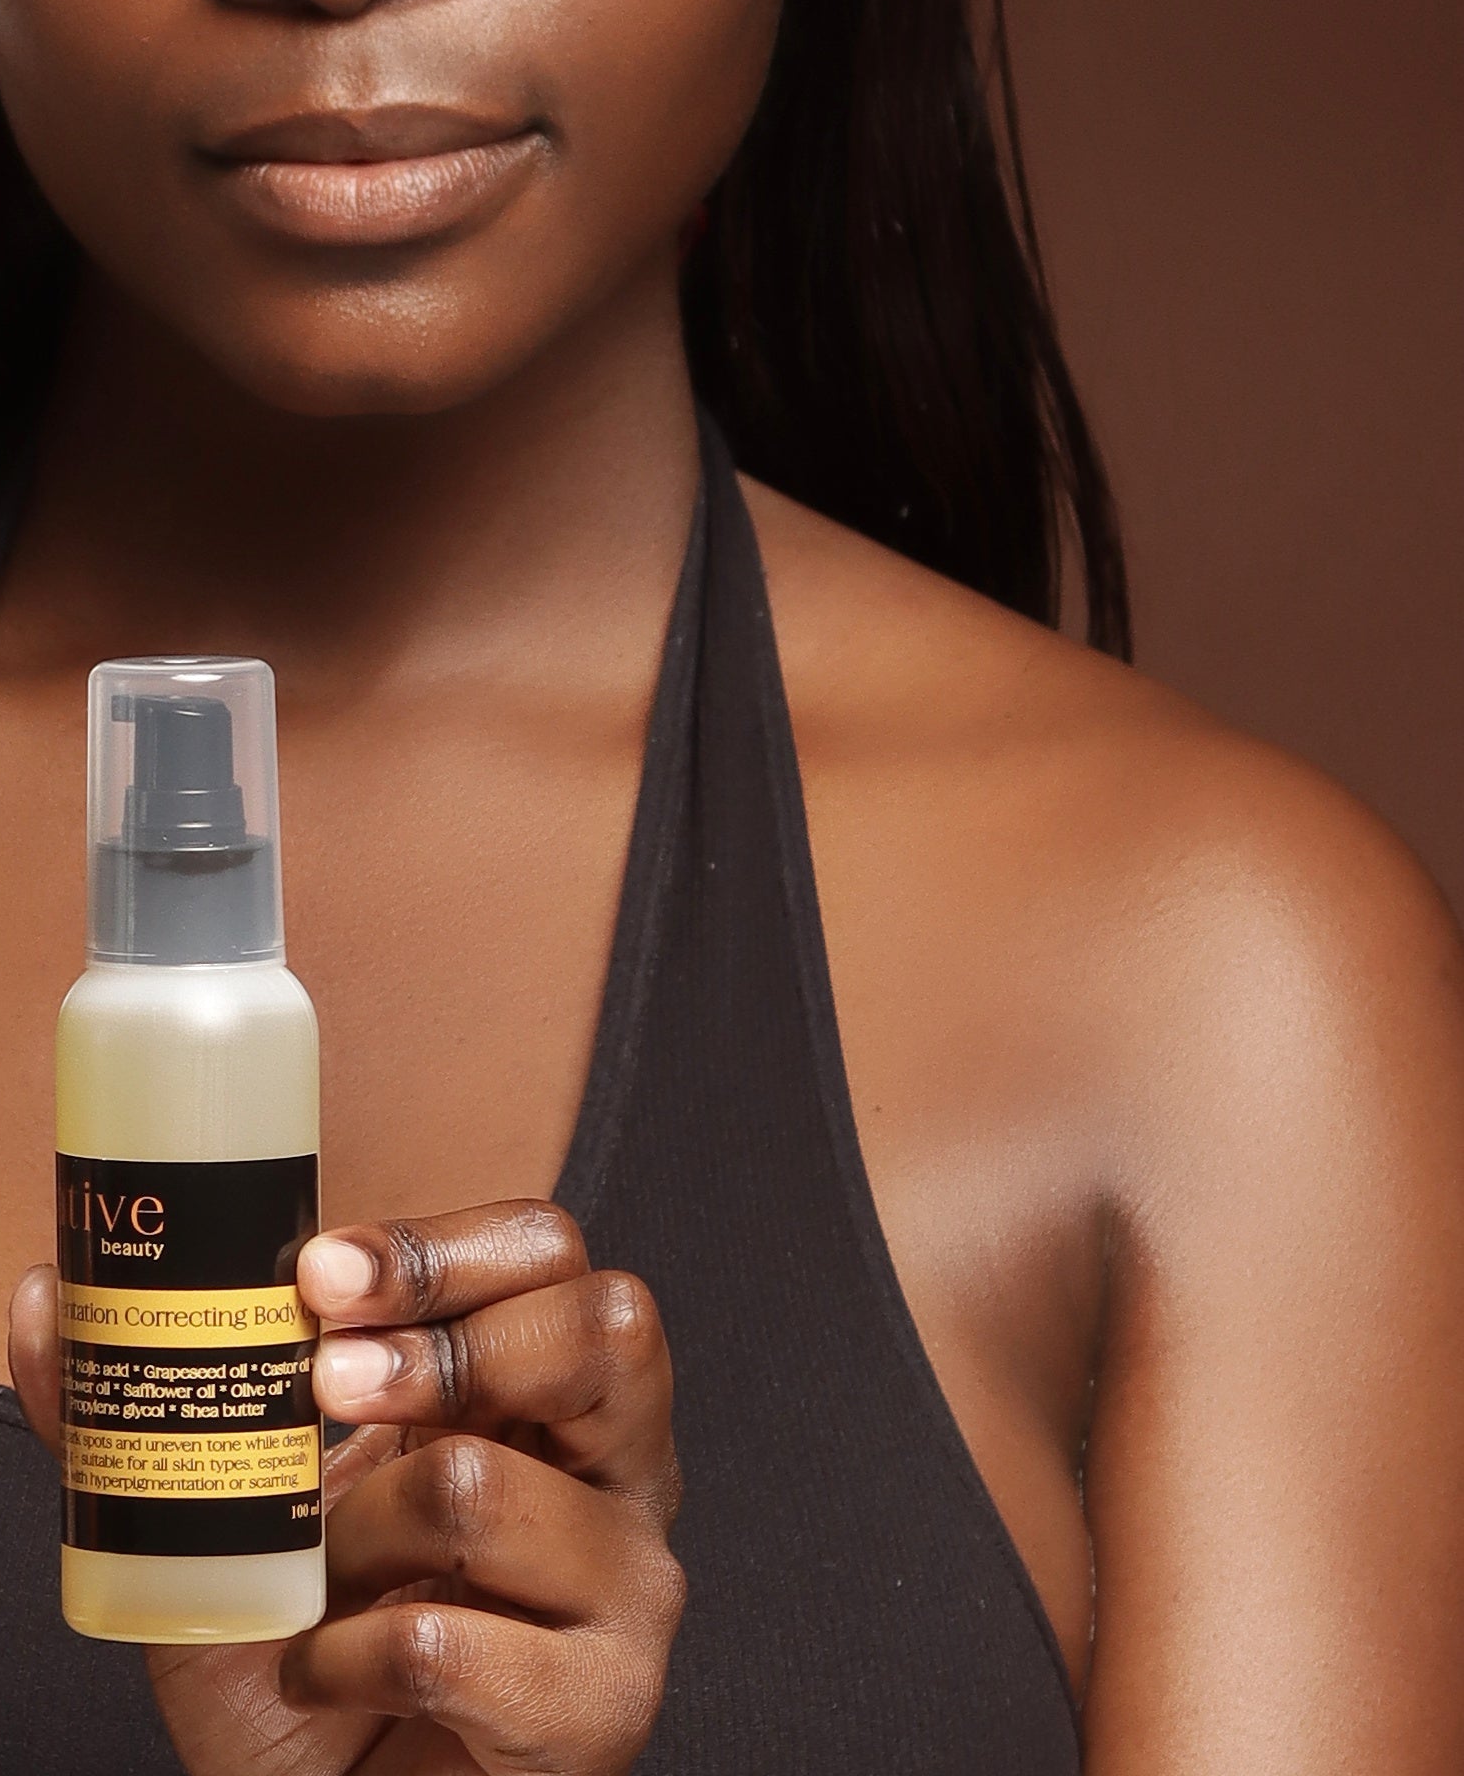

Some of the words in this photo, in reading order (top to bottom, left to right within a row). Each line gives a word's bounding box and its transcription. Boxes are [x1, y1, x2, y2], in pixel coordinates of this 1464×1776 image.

[101, 1238, 166, 1261] beauty
[125, 1306, 248, 1330] Correcting
[254, 1303, 298, 1326] Body
[103, 1363, 130, 1378] acid
[143, 1364, 227, 1383] Grapeseed
[229, 1363, 248, 1379] oil
[260, 1361, 299, 1377] Castor
[95, 1381, 111, 1395] oil
[123, 1383, 194, 1399] Safflower
[196, 1384, 216, 1399] oil
[230, 1382, 266, 1398] Olive
[267, 1380, 284, 1396] oil
[122, 1402, 165, 1420] glycol
[181, 1402, 220, 1419] Shea
[222, 1402, 267, 1418] butter
[83, 1435, 113, 1450] spots
[115, 1437, 141, 1451] and
[145, 1439, 202, 1452] uneven
[207, 1439, 242, 1452] tone
[245, 1435, 280, 1451] while
[81, 1453, 124, 1470] suitable
[126, 1455, 148, 1471] for
[152, 1457, 168, 1471] all
[172, 1457, 205, 1472] skin
[90, 1471, 225, 1493] hyperpigmentation
[229, 1478, 246, 1491] or
[291, 1503, 309, 1520] 100
